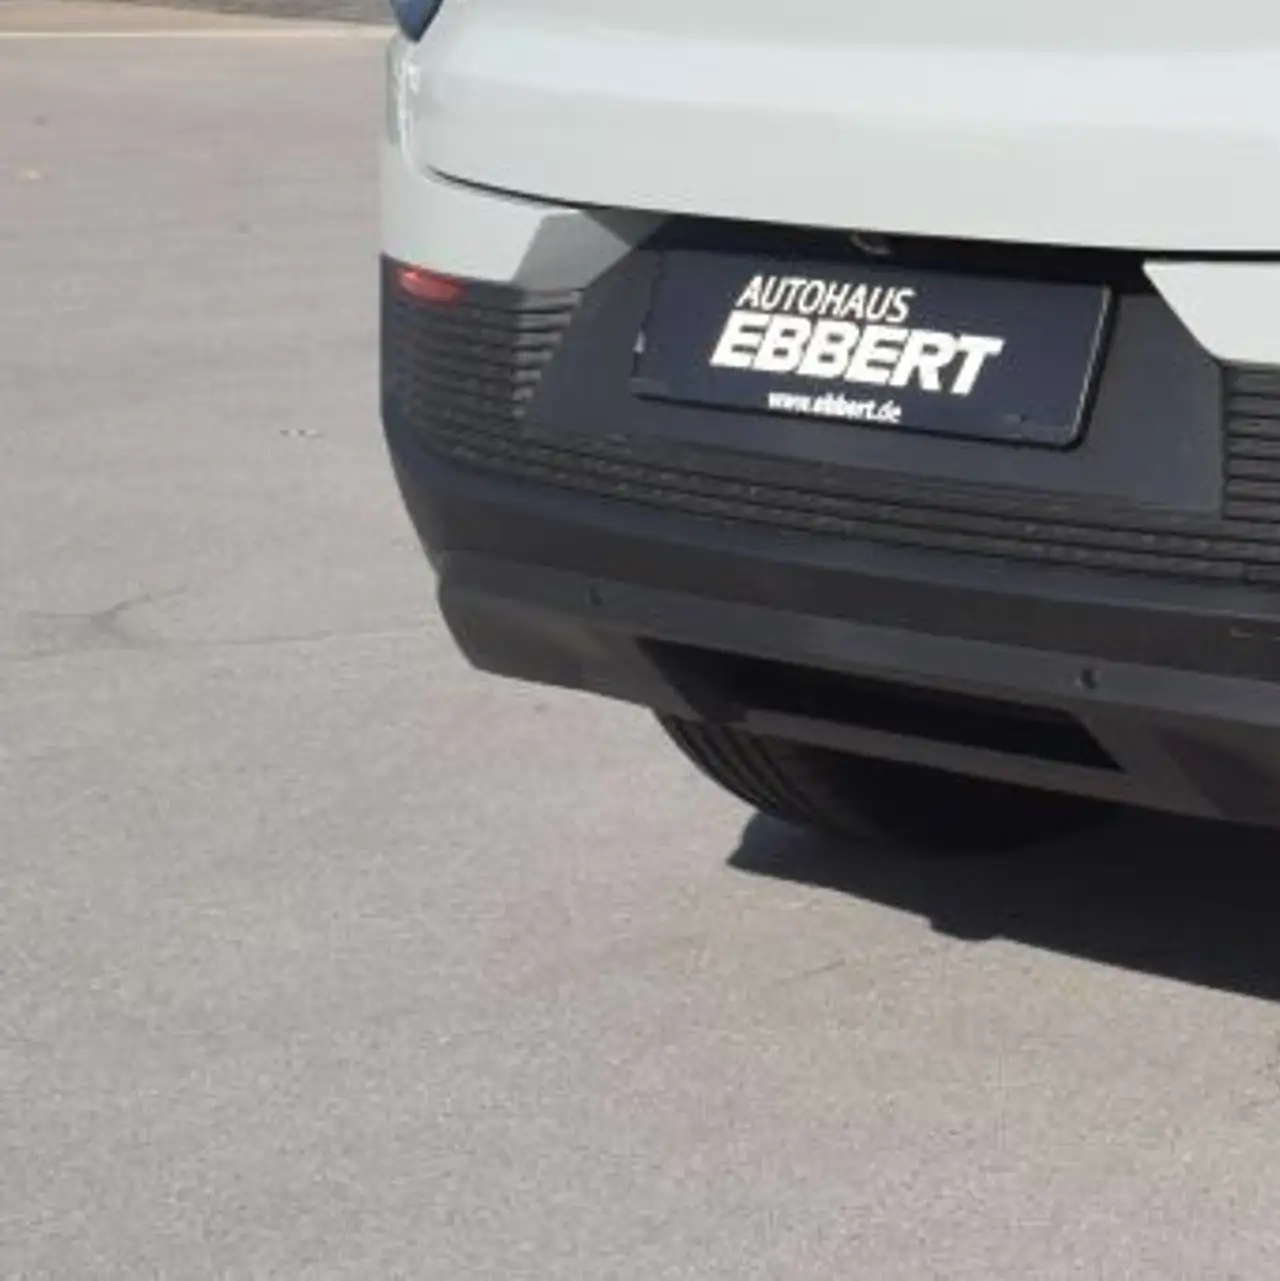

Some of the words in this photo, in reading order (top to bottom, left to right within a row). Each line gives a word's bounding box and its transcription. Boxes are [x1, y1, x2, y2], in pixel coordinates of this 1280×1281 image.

[735, 274, 915, 322] AUTOHAUS
[709, 310, 1005, 395] EBBERT
[768, 392, 902, 423] www.ebbert.de
